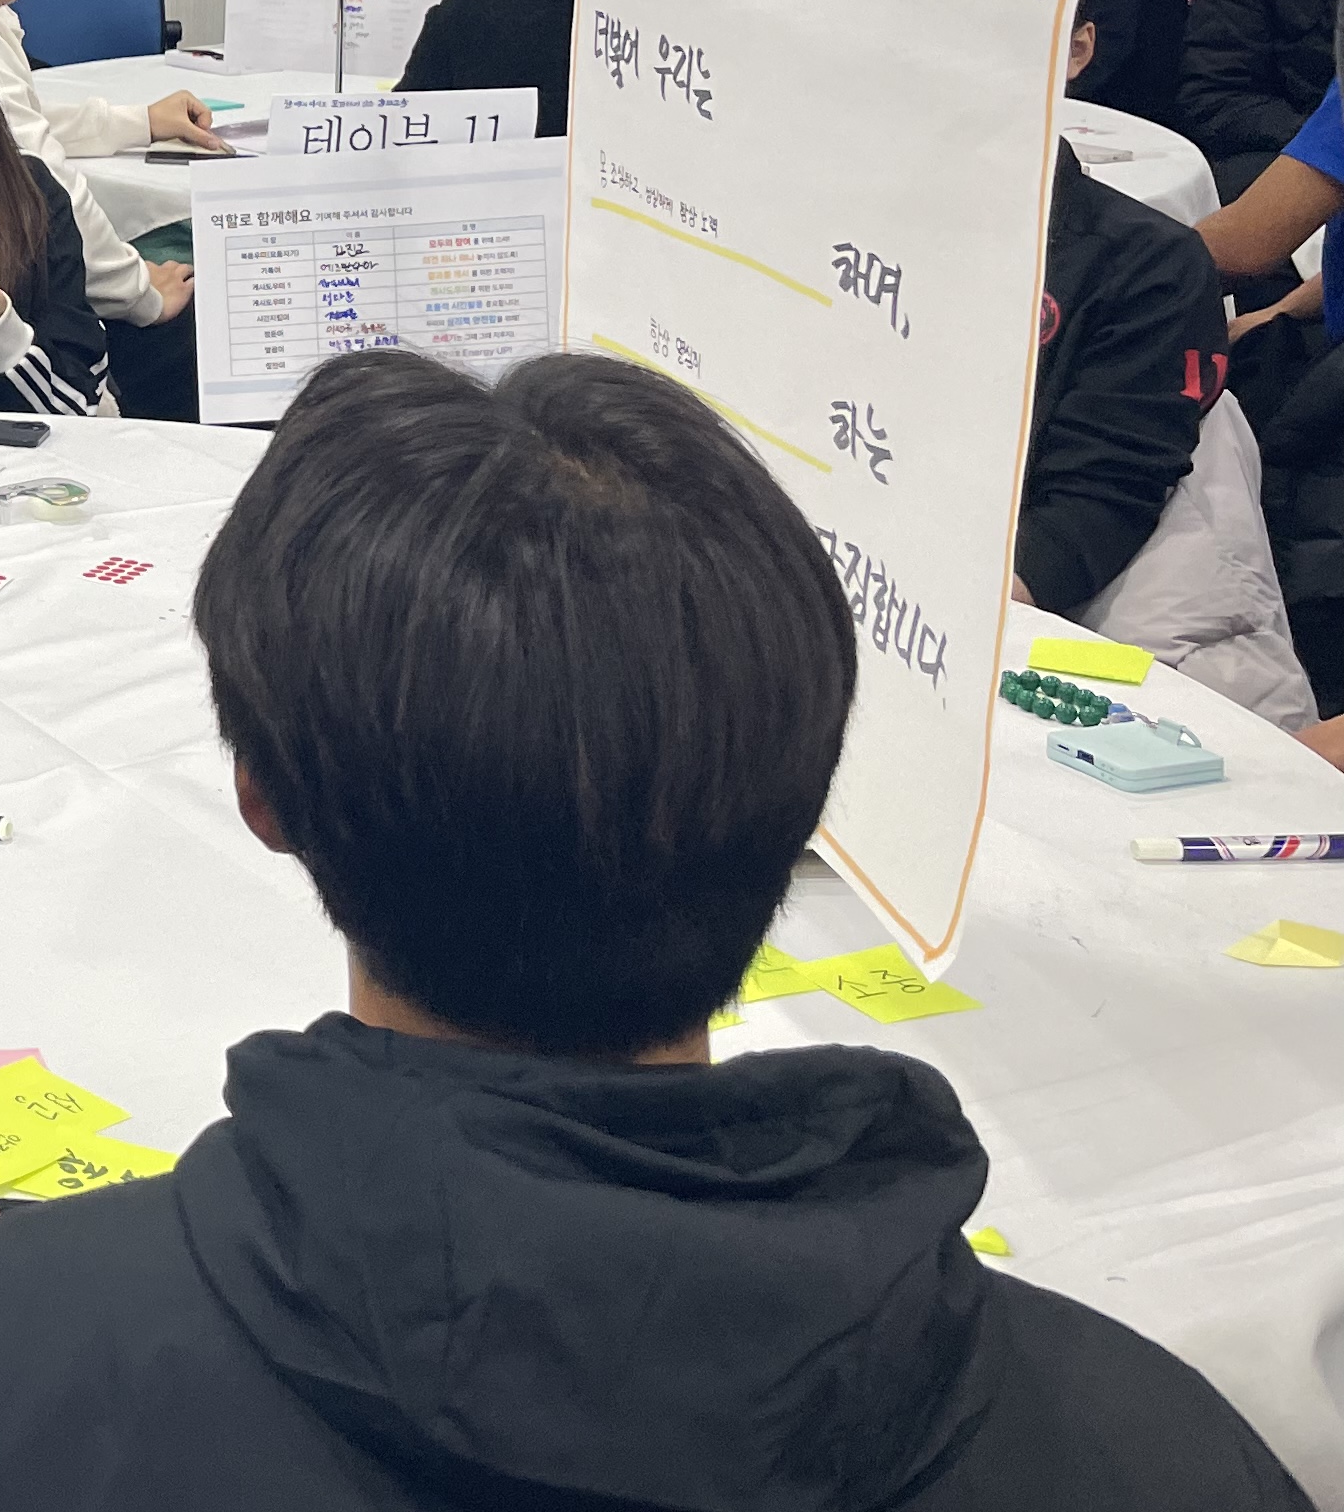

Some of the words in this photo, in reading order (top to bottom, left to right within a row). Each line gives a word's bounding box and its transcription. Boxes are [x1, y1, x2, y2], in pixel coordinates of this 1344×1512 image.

[592, 8, 641, 90] 더불어
[653, 31, 716, 121] 우리는
[465, 114, 500, 144] 11
[827, 399, 894, 487] 하는
